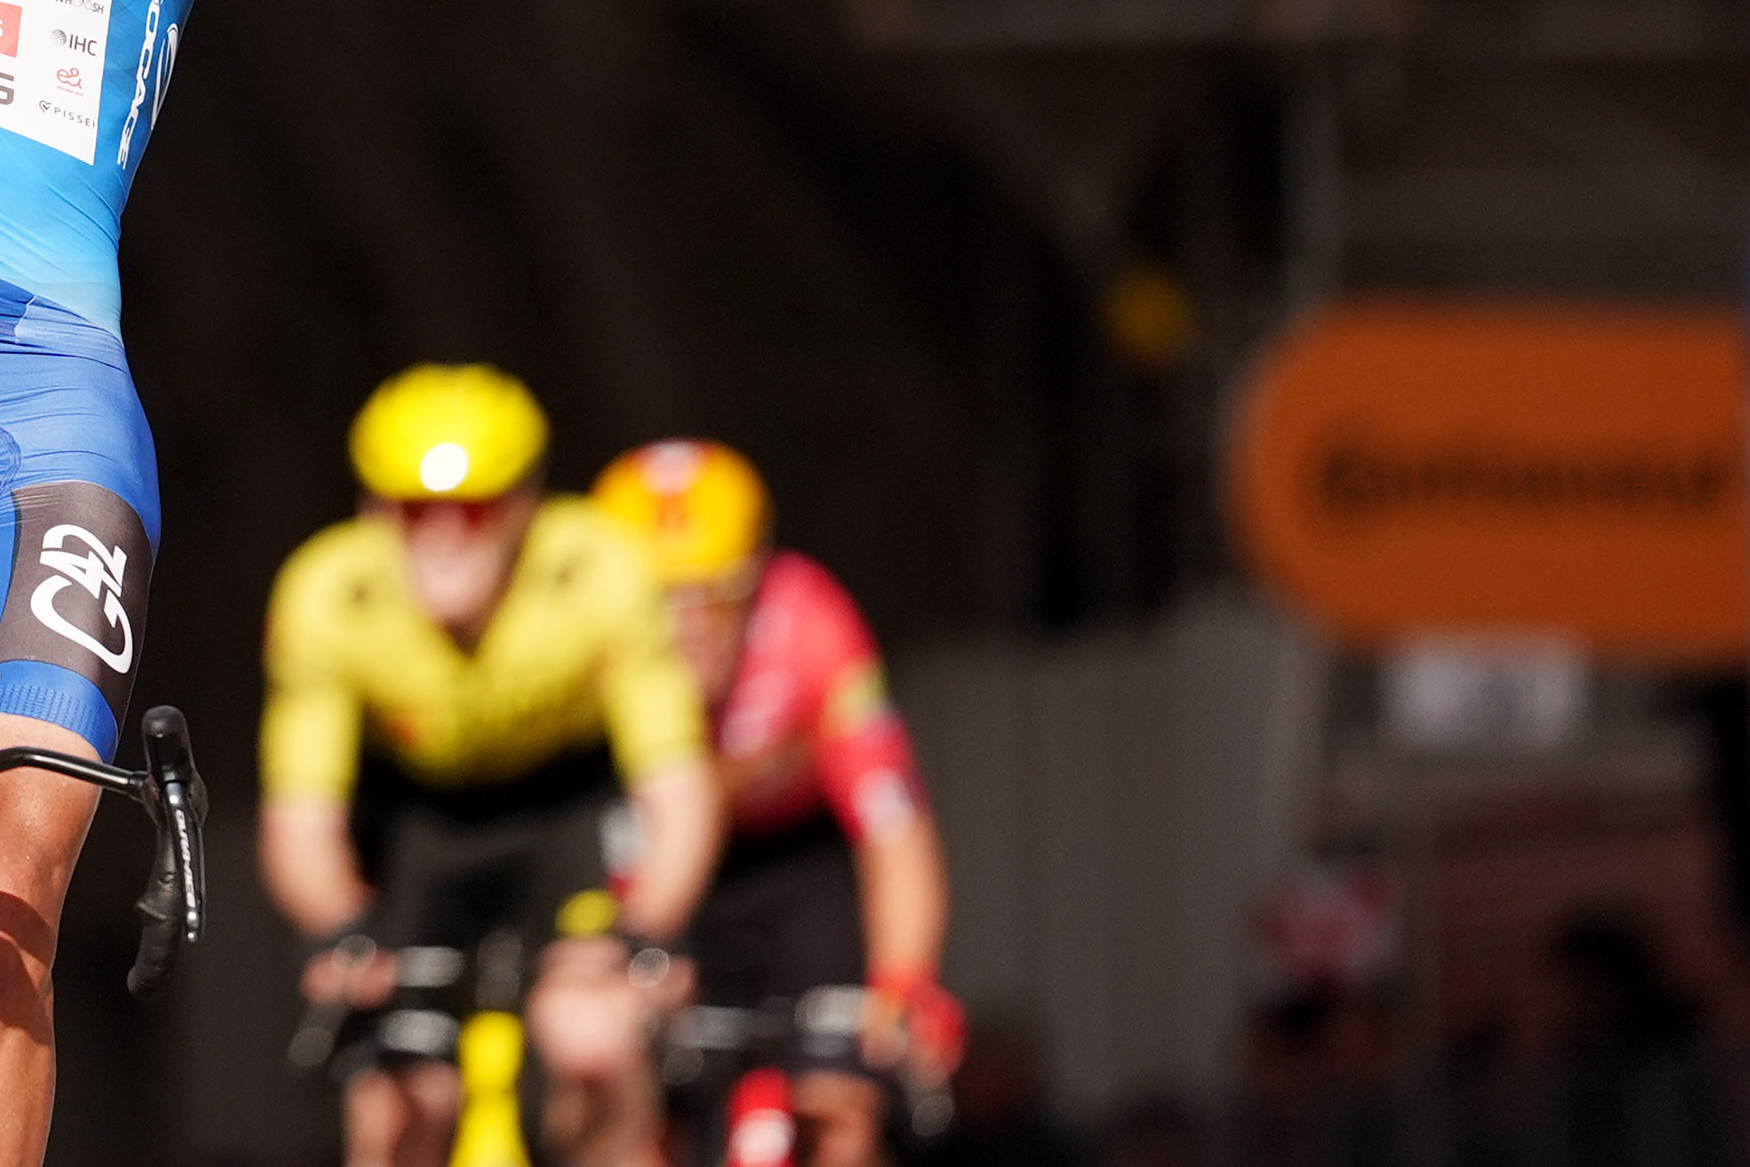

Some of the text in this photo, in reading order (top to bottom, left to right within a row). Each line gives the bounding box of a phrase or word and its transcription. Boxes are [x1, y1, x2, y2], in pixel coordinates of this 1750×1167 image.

[69, 34, 98, 56] IHC
[54, 106, 95, 129] PISSEI
[31, 524, 133, 674] G42
